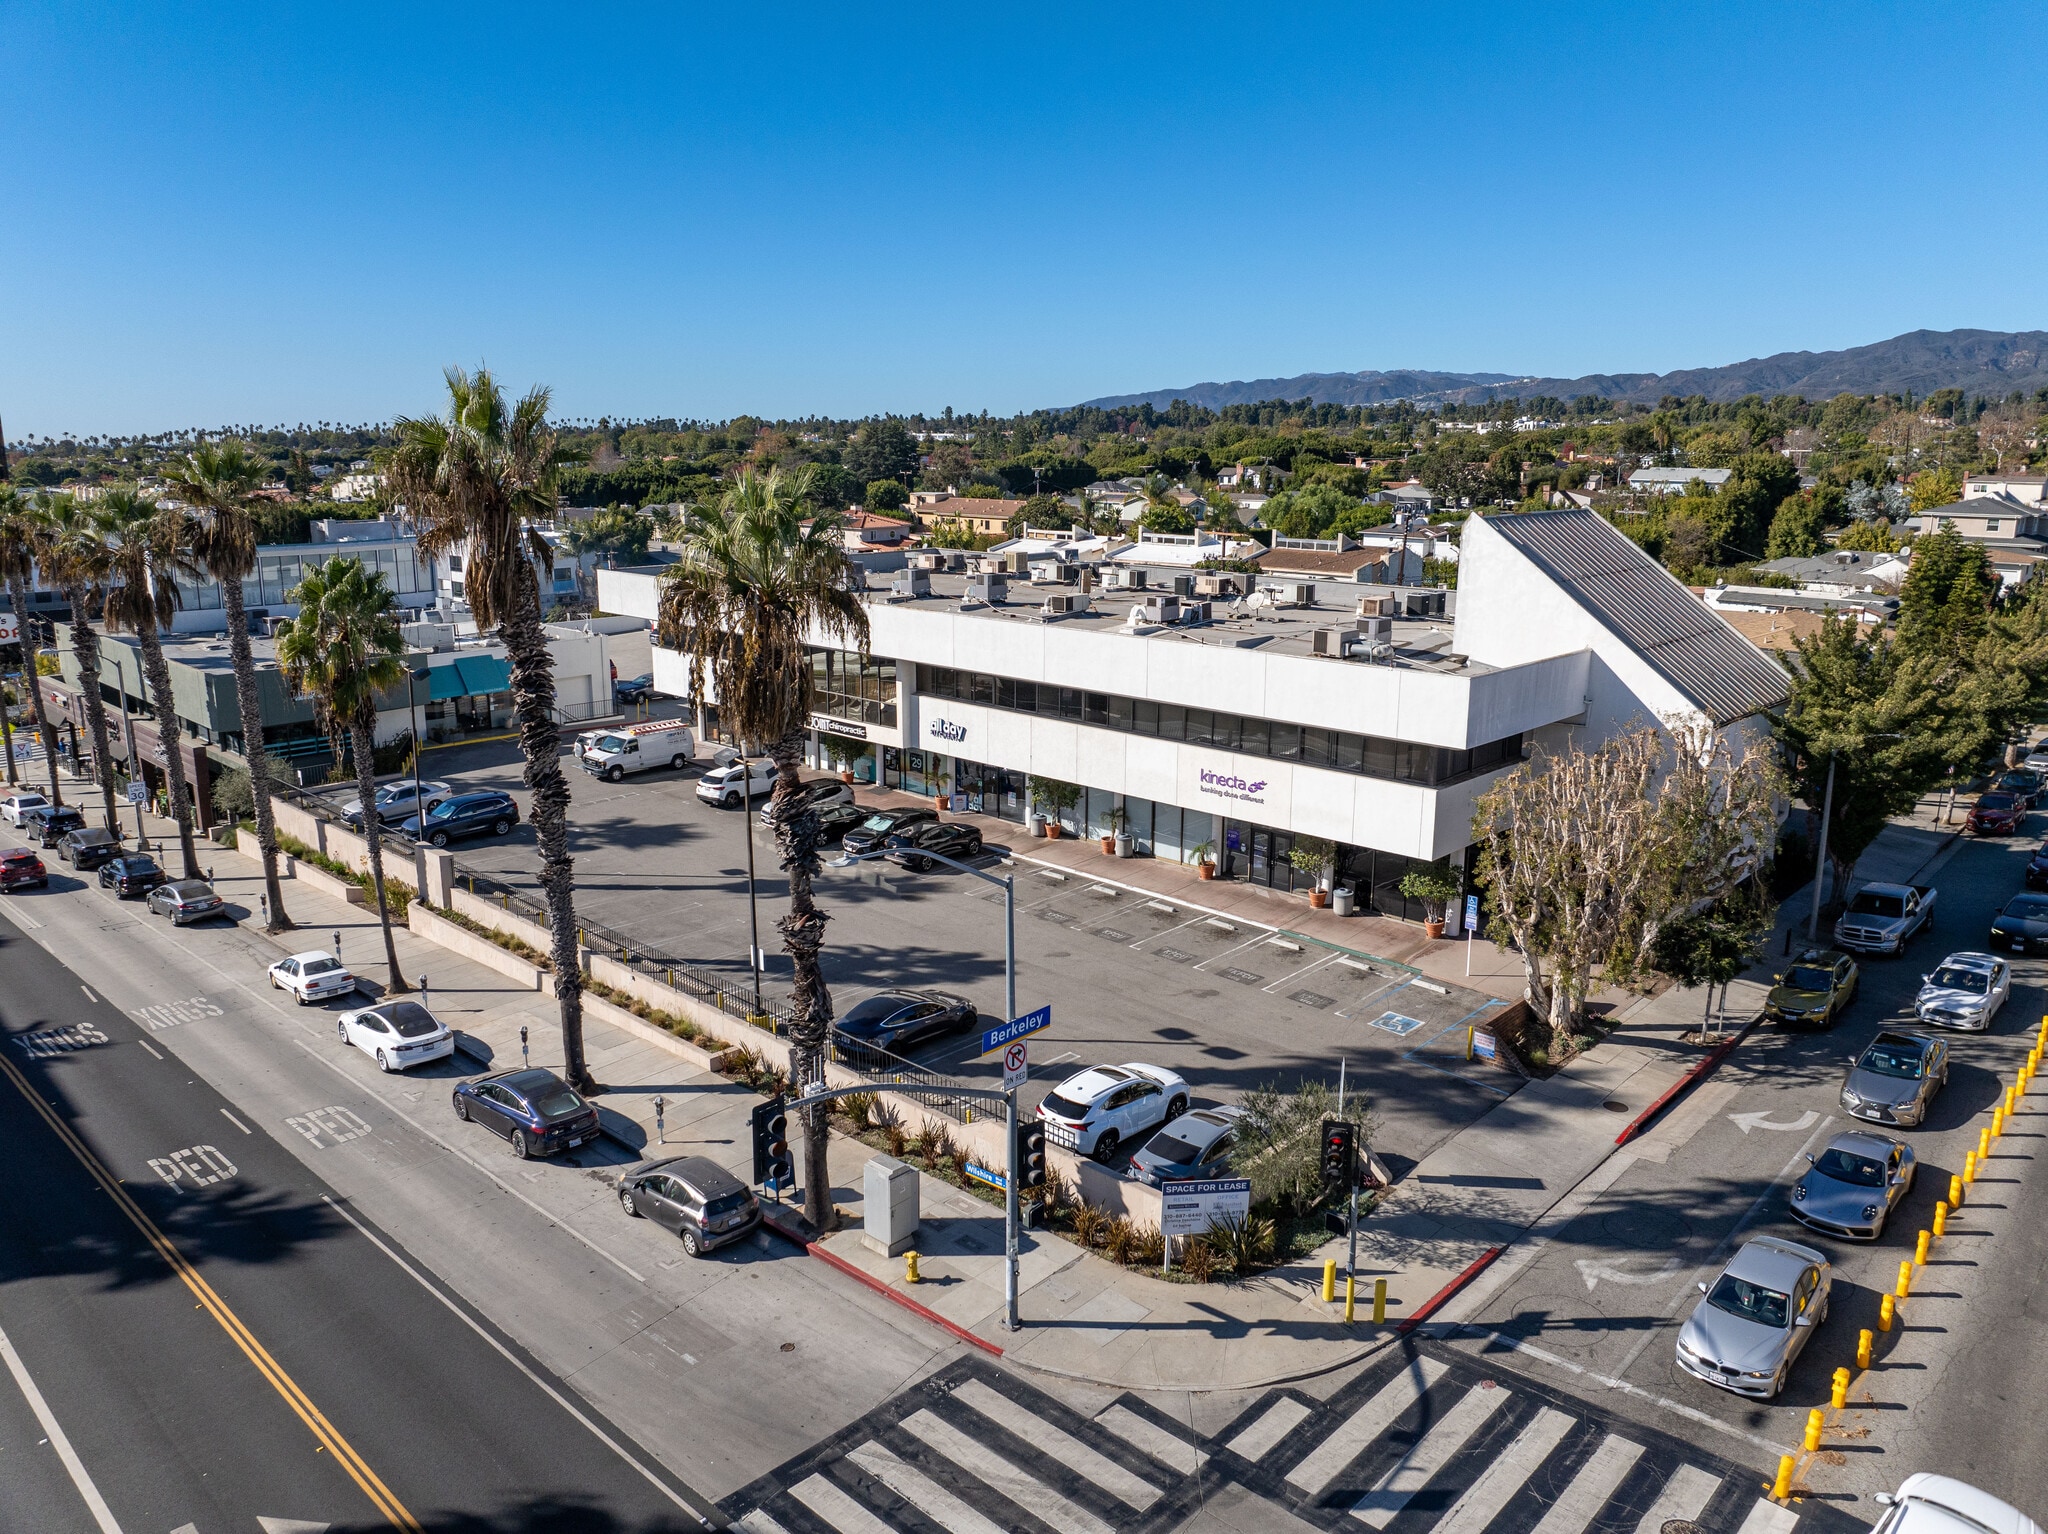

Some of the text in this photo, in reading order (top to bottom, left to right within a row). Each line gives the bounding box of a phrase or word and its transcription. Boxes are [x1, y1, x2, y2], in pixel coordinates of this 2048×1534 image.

[829, 721, 866, 736] chiropractic
[930, 718, 964, 740] all day
[1200, 768, 1246, 790] kinecta
[131, 792, 144, 800] 30
[1200, 785, 1264, 804] banking done different
[130, 997, 224, 1030] XINGS
[990, 1013, 1043, 1045] Berkeley
[12, 1022, 109, 1060] XINGS
[1005, 1071, 1026, 1086] ON RED
[285, 1105, 372, 1149] PED
[147, 1145, 238, 1194] PED
[966, 1164, 993, 1182] Wilshire
[1166, 1182, 1247, 1193] SPACE FOR LEASE
